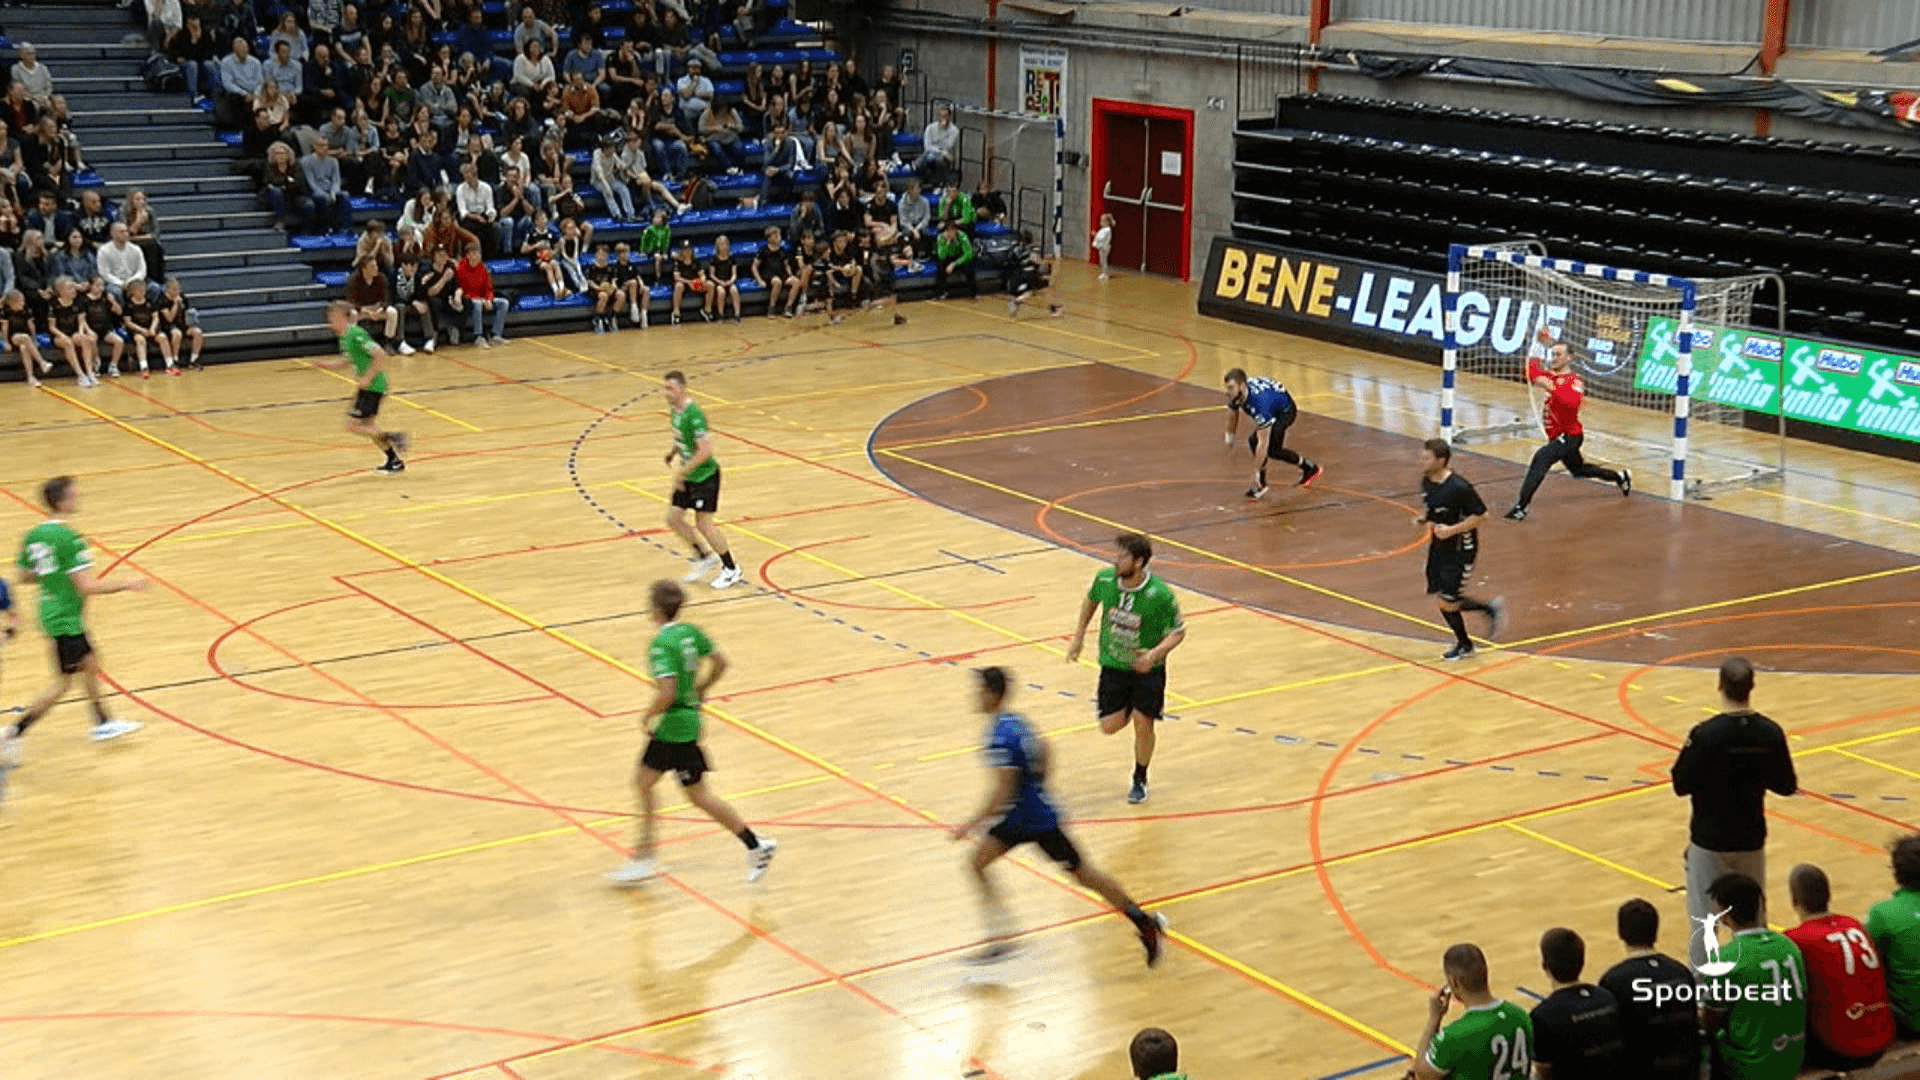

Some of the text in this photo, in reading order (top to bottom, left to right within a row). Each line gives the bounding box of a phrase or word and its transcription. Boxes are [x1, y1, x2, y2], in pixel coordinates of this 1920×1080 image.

[1216, 247, 1568, 360] BENE-LEAGUE
[1820, 353, 1861, 371] Hubo
[1826, 927, 1879, 975] 73
[1760, 953, 1804, 1007] 71
[1491, 1027, 1529, 1080] 24
